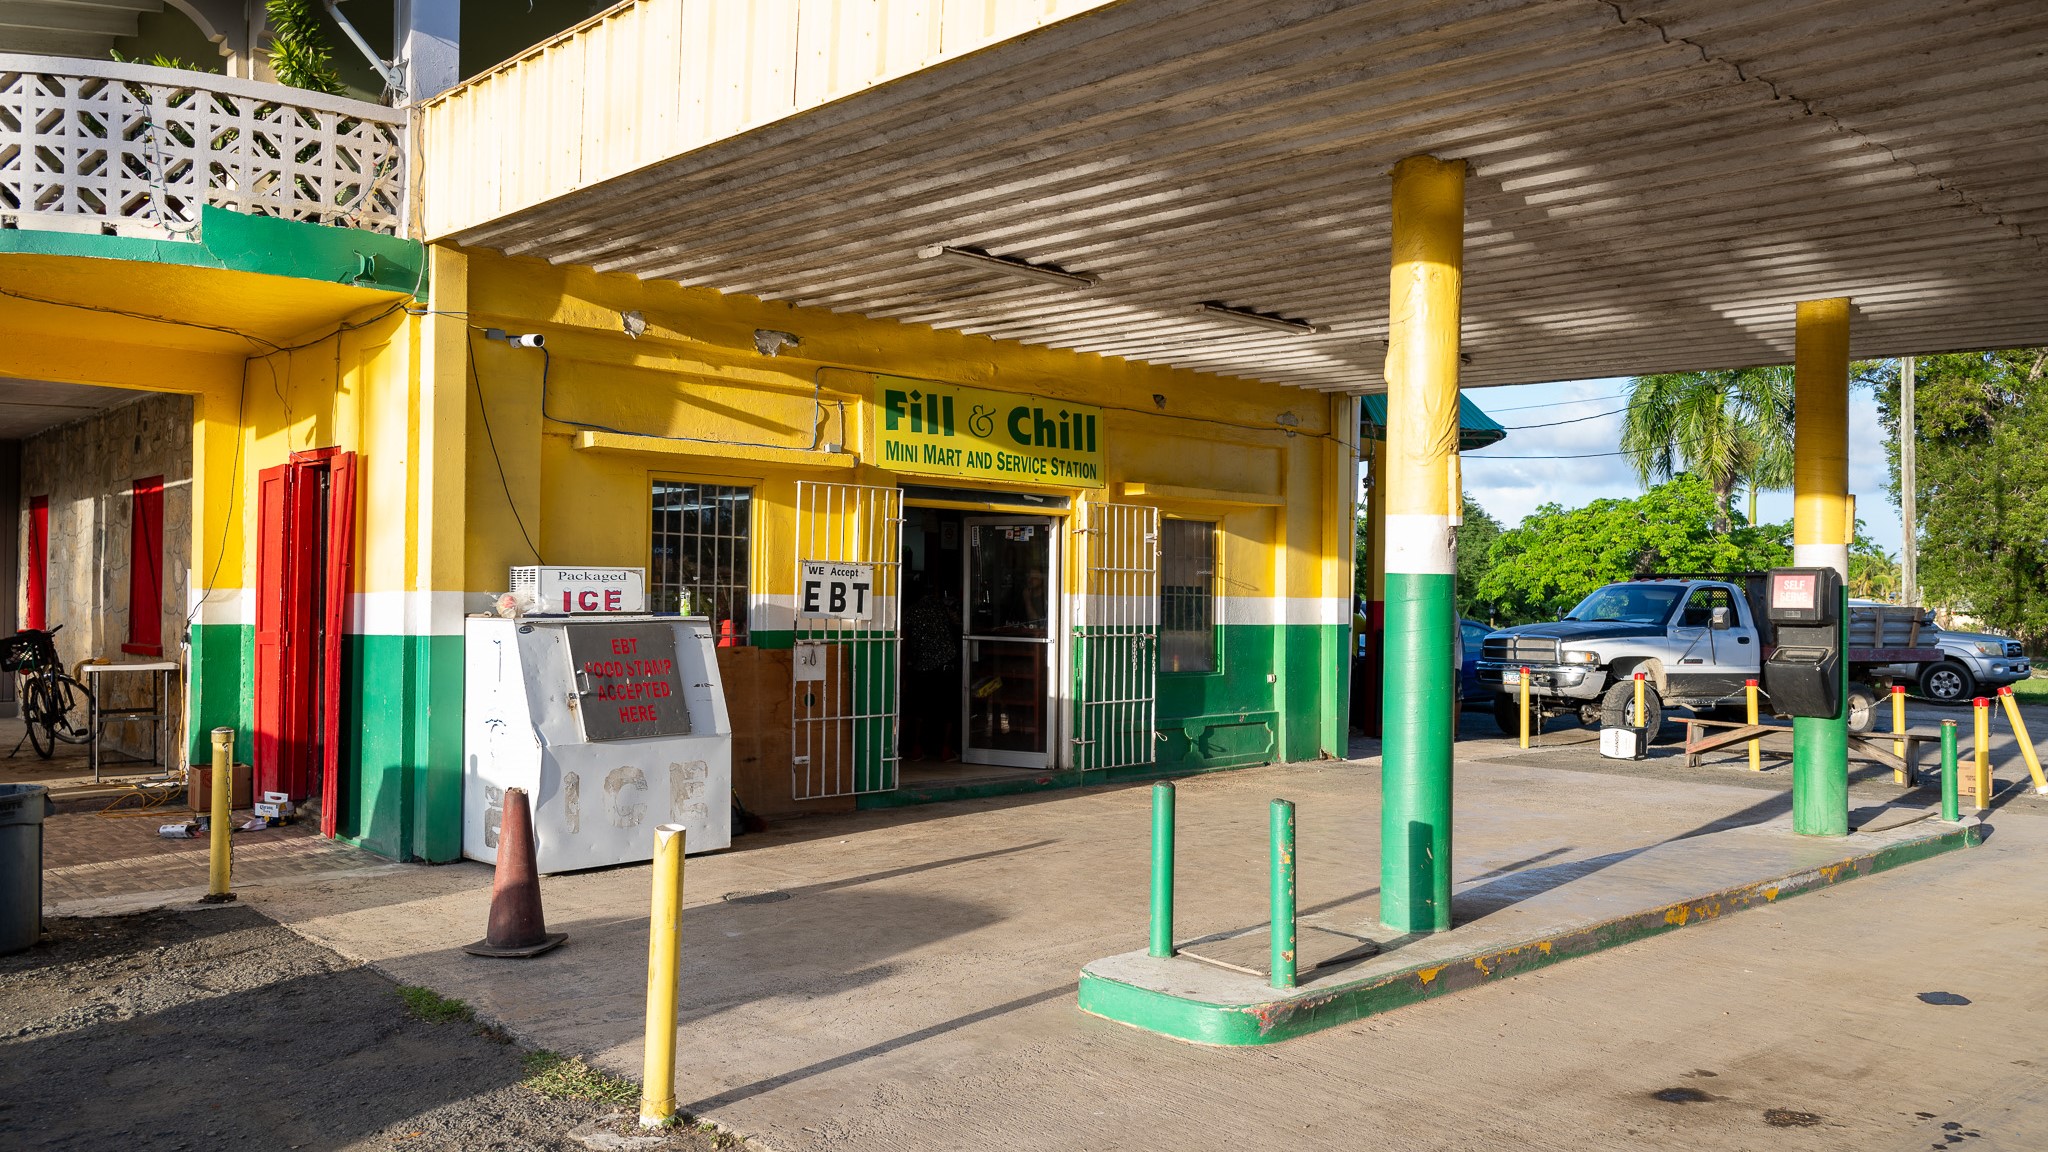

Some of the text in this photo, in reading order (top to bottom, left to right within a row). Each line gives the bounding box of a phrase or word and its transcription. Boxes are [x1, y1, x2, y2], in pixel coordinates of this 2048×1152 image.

[885, 389, 1096, 453] Fill & Chill
[966, 451, 993, 470] AND
[558, 571, 627, 583] Packaged
[808, 566, 859, 579] WE Accept
[1783, 580, 1806, 590] SELF
[563, 586, 622, 613] ICE
[803, 580, 870, 615] EBT
[611, 638, 638, 655] EBT
[626, 659, 672, 678] STAMP
[598, 681, 670, 702] ACCEPTED
[619, 704, 657, 724] HERE
